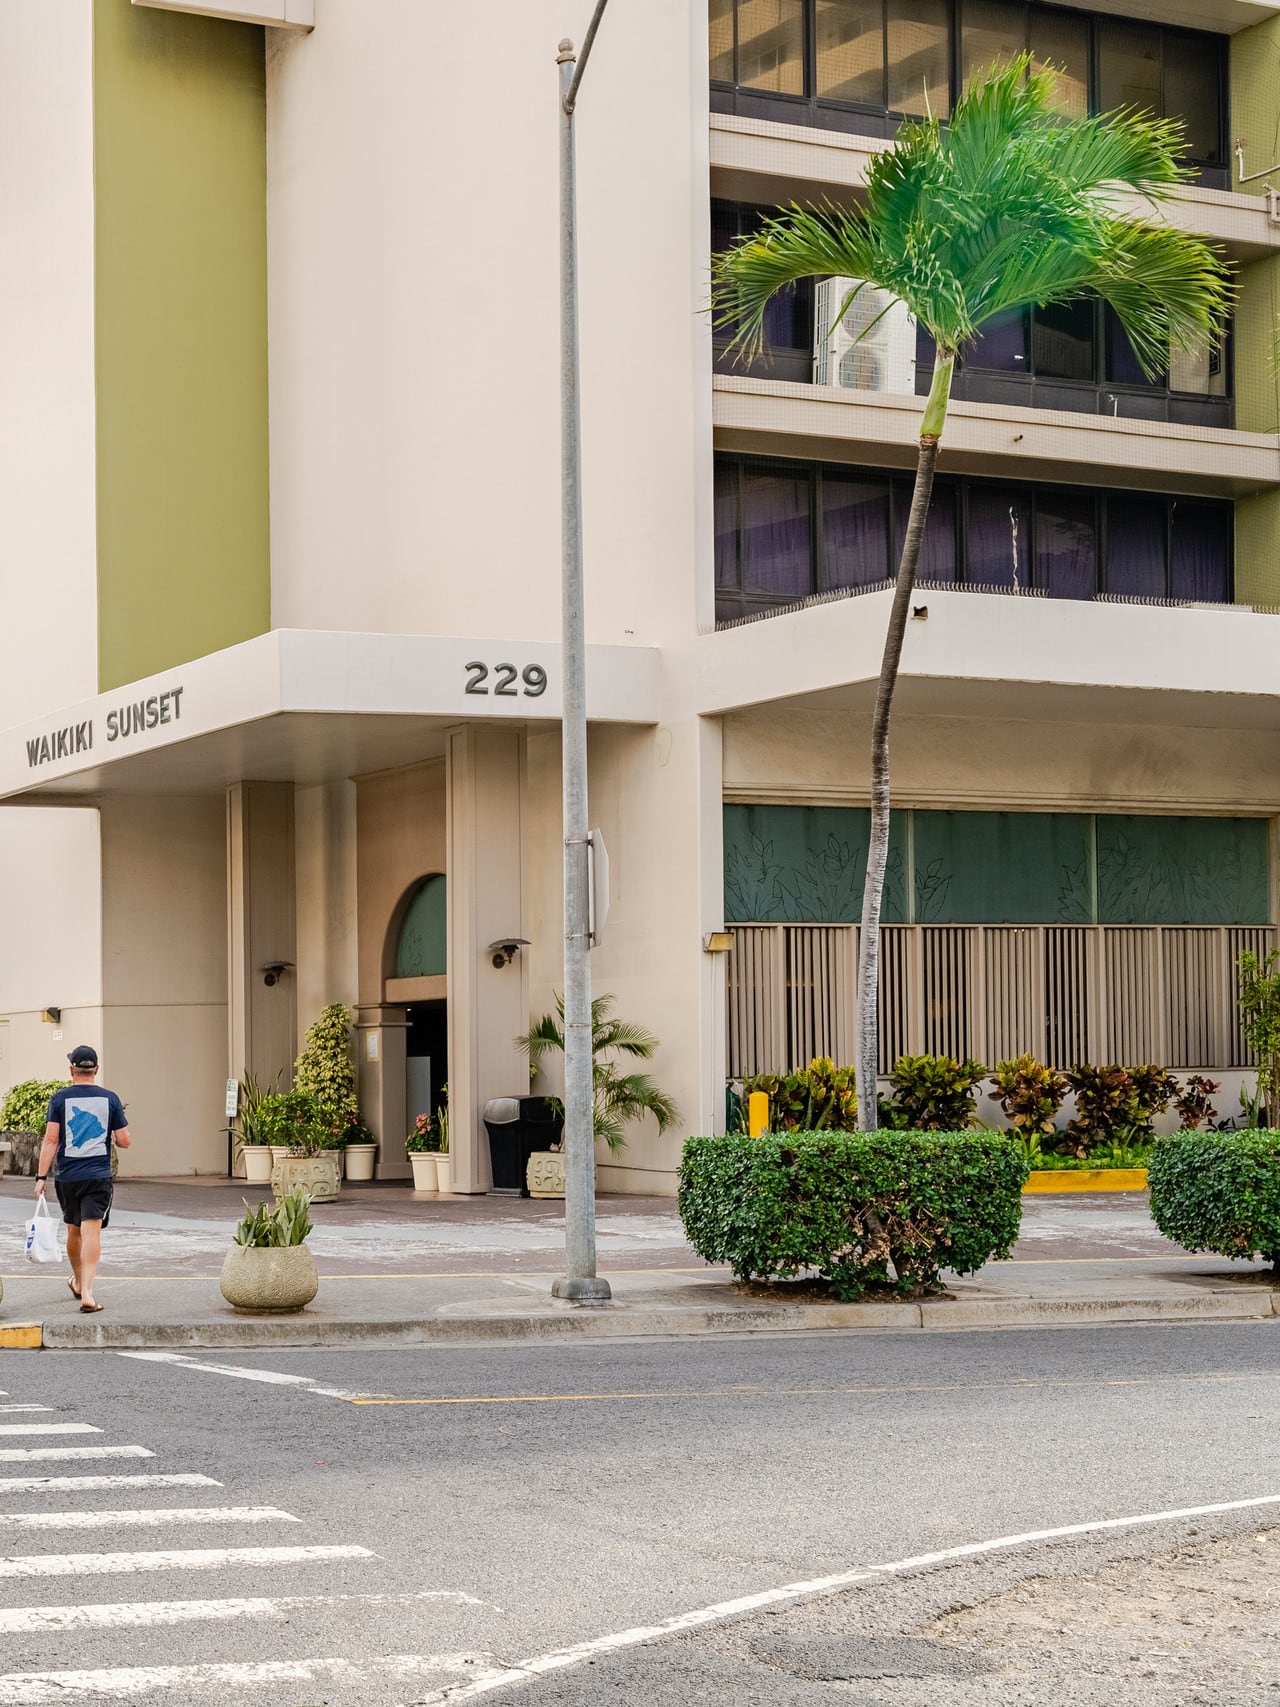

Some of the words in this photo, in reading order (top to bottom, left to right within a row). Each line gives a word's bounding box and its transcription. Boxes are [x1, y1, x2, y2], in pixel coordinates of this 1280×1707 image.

[465, 661, 548, 698] 229
[26, 719, 93, 768] WAIKIKI
[106, 686, 184, 742] SUNSET
